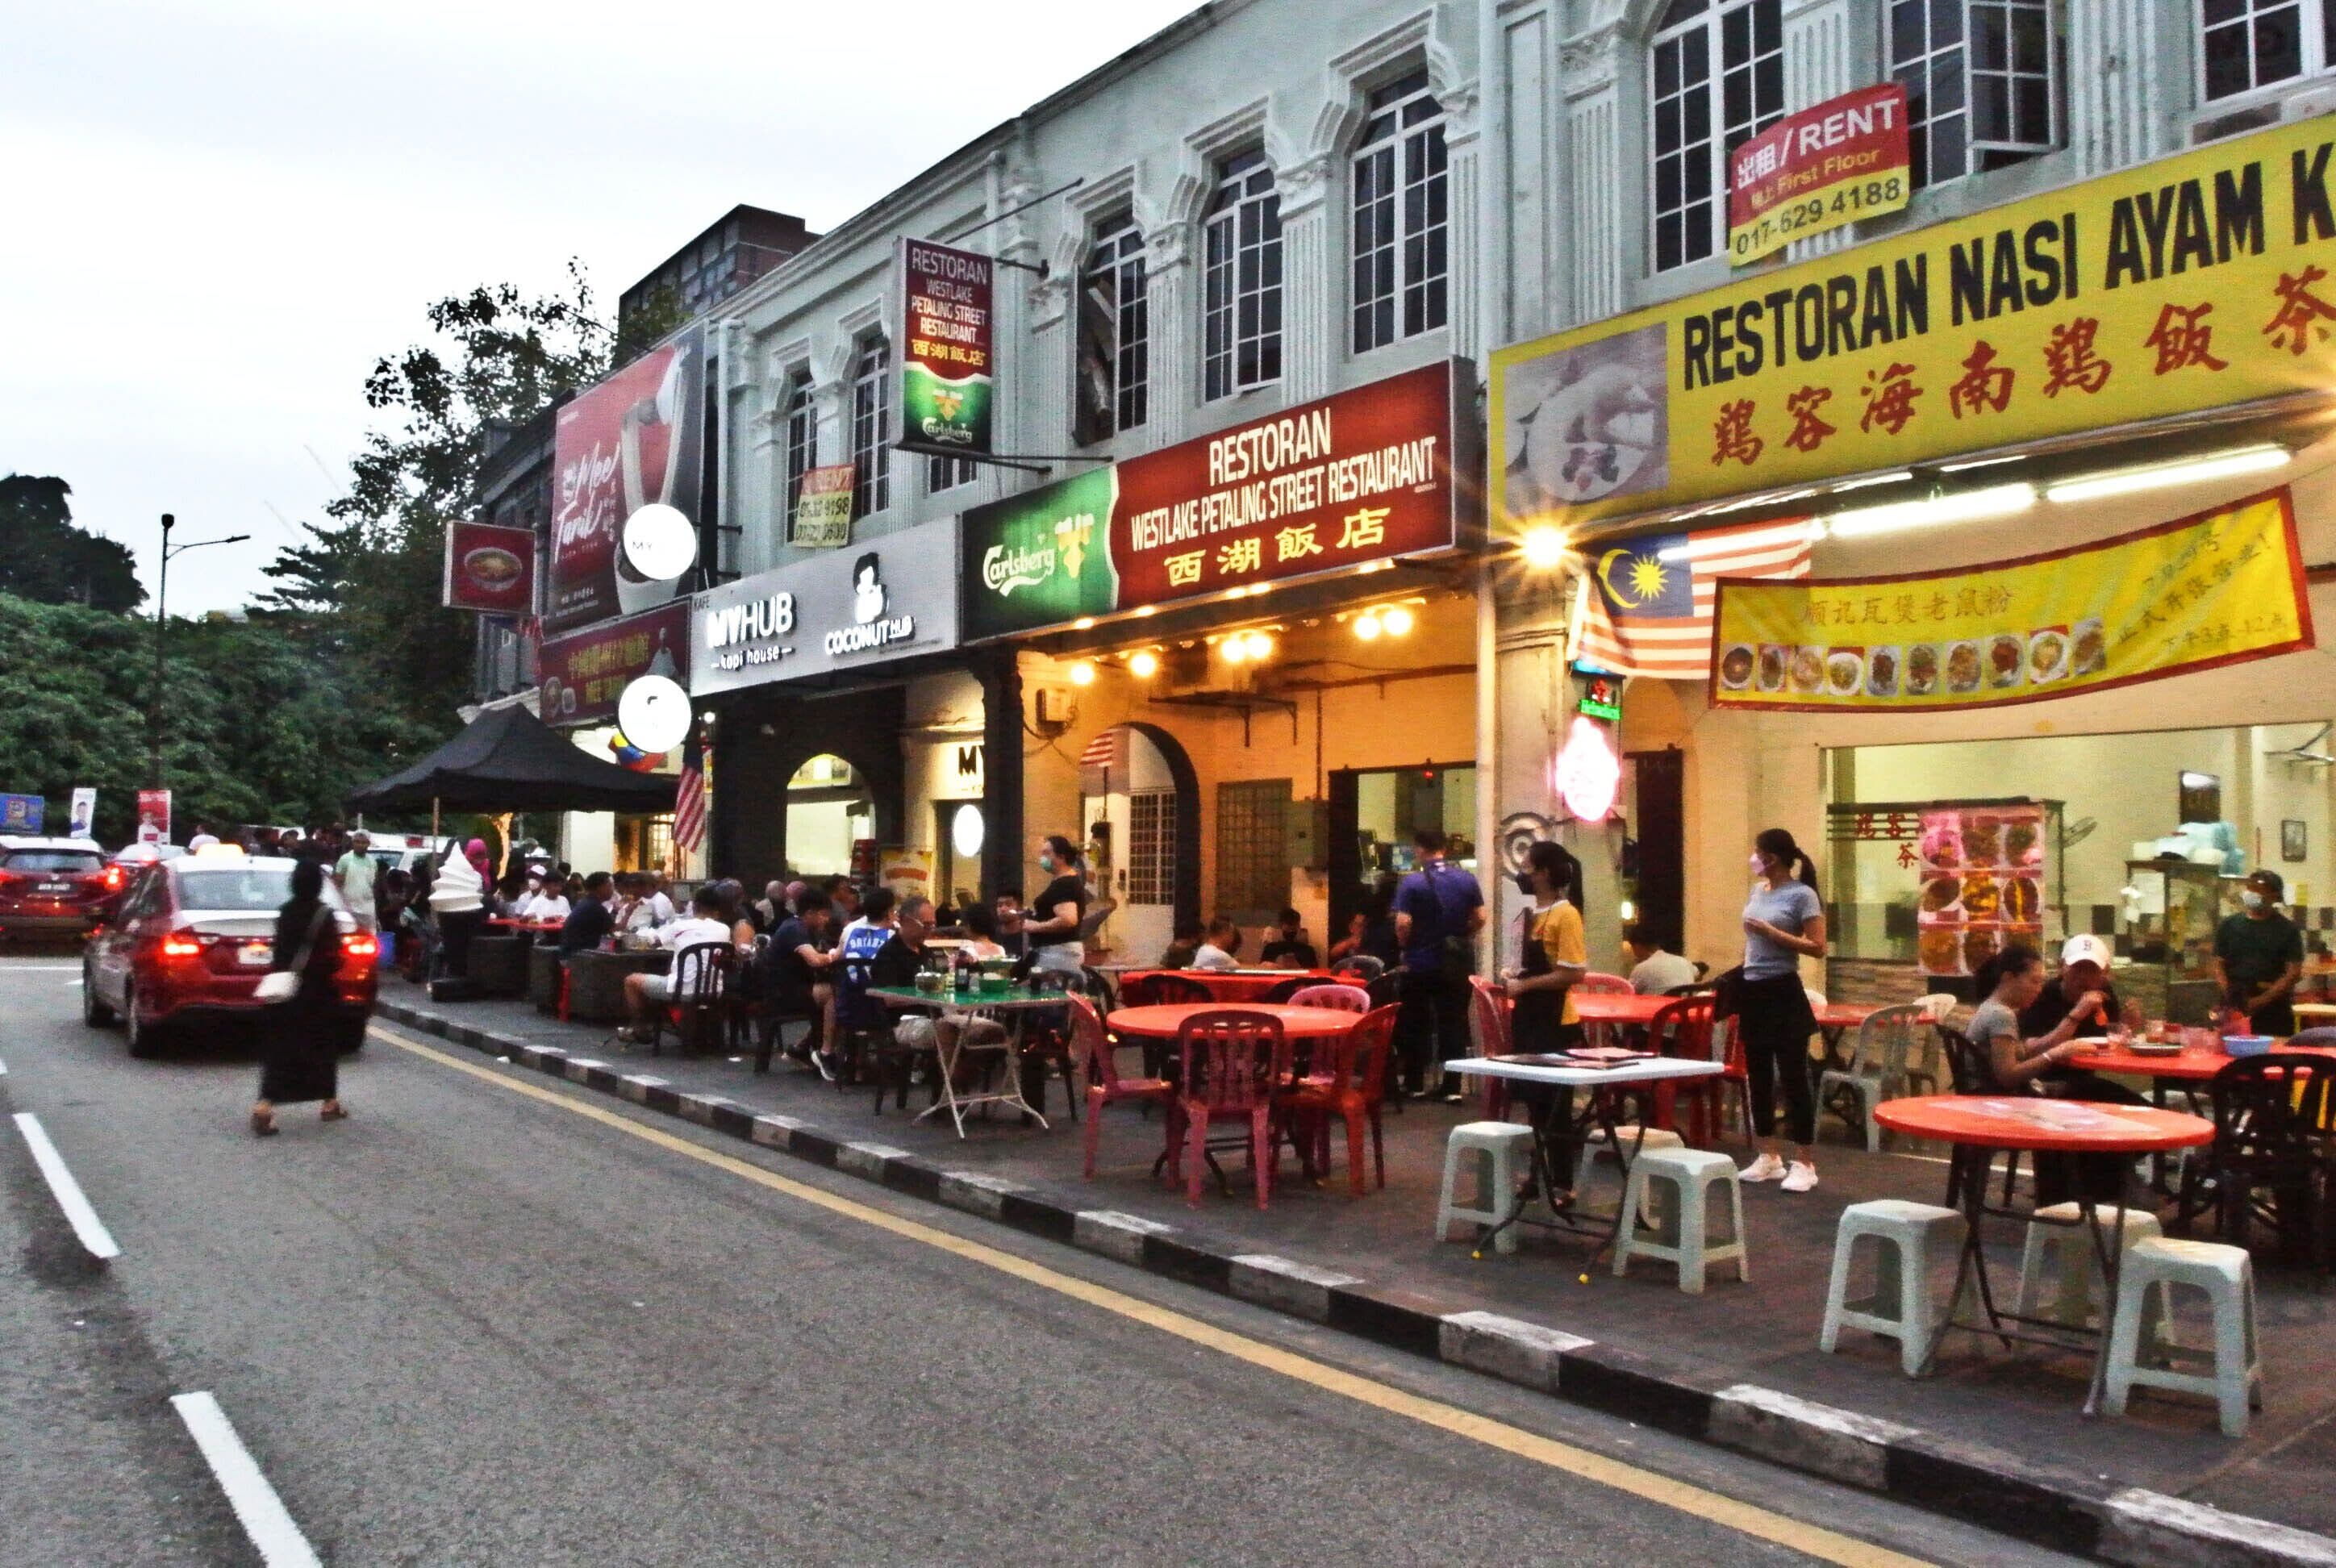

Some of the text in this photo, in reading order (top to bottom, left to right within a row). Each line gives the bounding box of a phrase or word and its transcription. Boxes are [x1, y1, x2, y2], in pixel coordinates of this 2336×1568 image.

[1799, 98, 1900, 156] RENT
[1777, 166, 1818, 196] First
[1824, 148, 1880, 176] Floor
[1830, 177, 1901, 215] 4188
[912, 247, 987, 285] RESTORAN
[1683, 252, 1929, 390] RESTORAN
[1950, 212, 2079, 326] NASI
[2104, 161, 2265, 290] AYAM
[911, 295, 987, 327] PETALING STREET
[927, 278, 973, 303] WESTLAKE
[920, 317, 977, 344] RESTAURANT
[911, 339, 986, 366] 西湖飯店
[922, 417, 973, 444] Carlsberg
[1210, 407, 1331, 486] RESTORAN
[1131, 436, 1437, 553] WESTLAKE PETALING STREET RESTAURANT
[1164, 507, 1391, 587] 西湖飯店
[982, 544, 1055, 594] Carlsberg
[707, 592, 795, 648] MYHUB
[720, 646, 779, 671] kopi house
